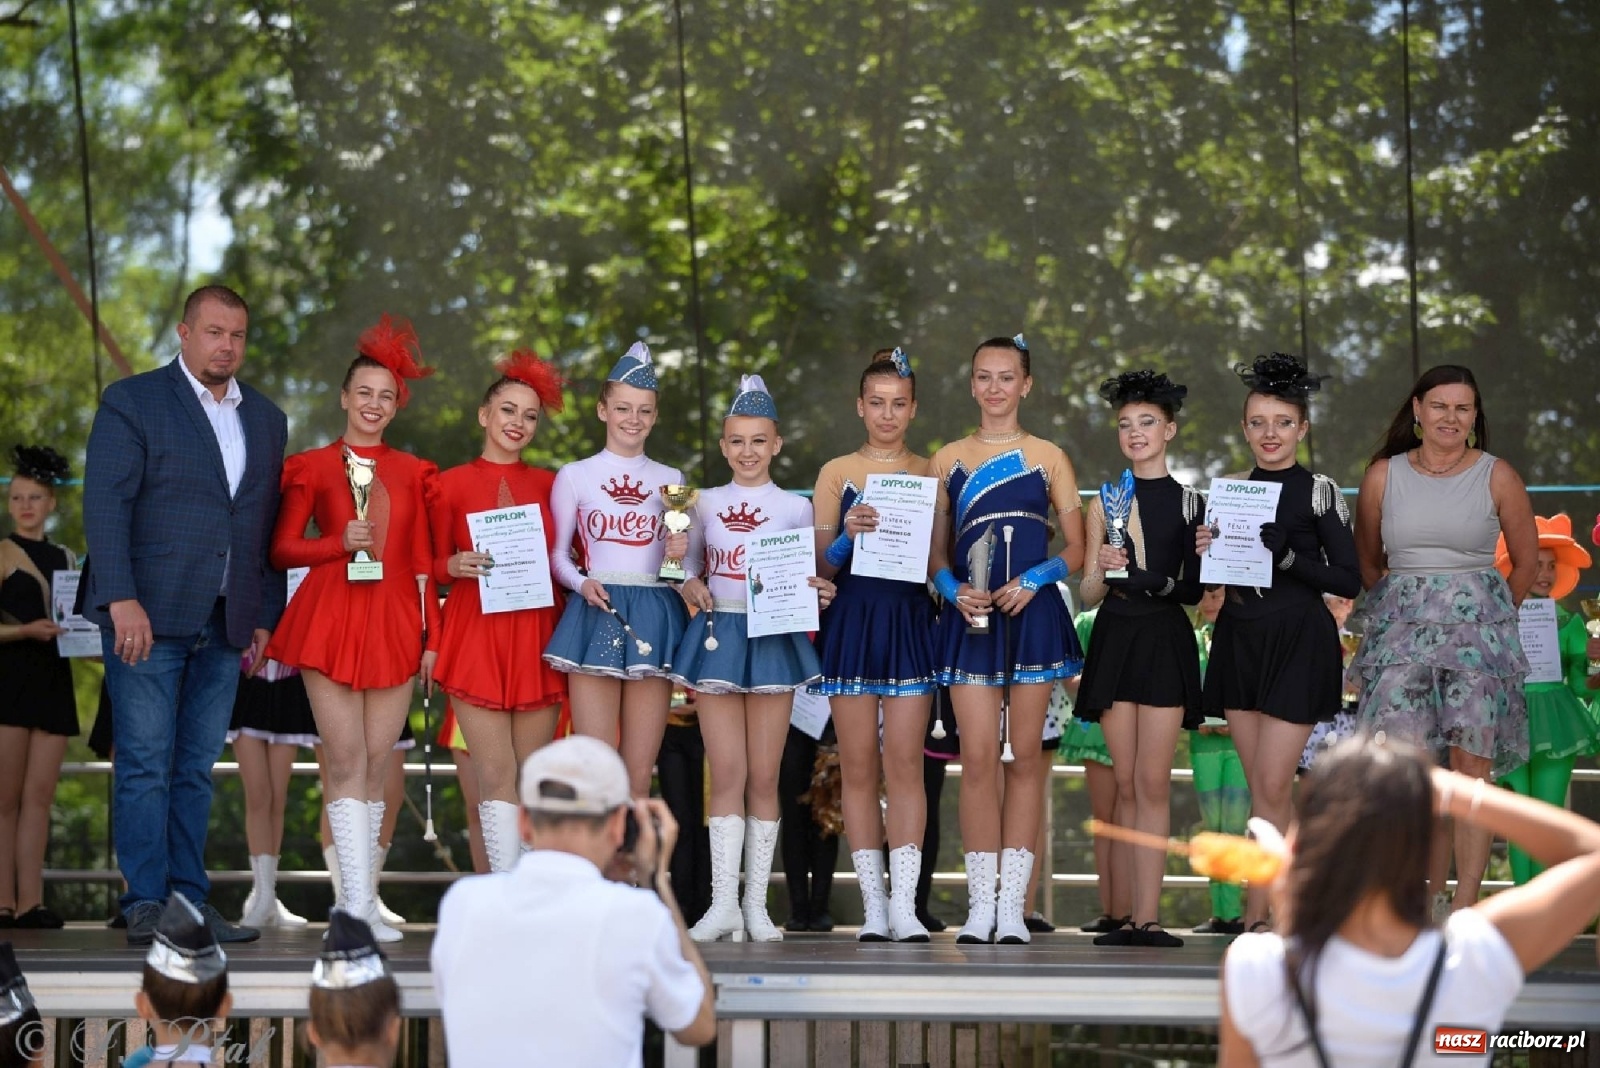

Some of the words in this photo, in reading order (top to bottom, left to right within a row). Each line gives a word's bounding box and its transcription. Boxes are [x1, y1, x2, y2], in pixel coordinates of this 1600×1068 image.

[881, 479, 922, 490] DYPLOM
[1226, 484, 1267, 495] DYPLOM
[484, 511, 526, 524] DYPLOM
[587, 509, 668, 547] Queen
[760, 534, 800, 547] DYPLOM
